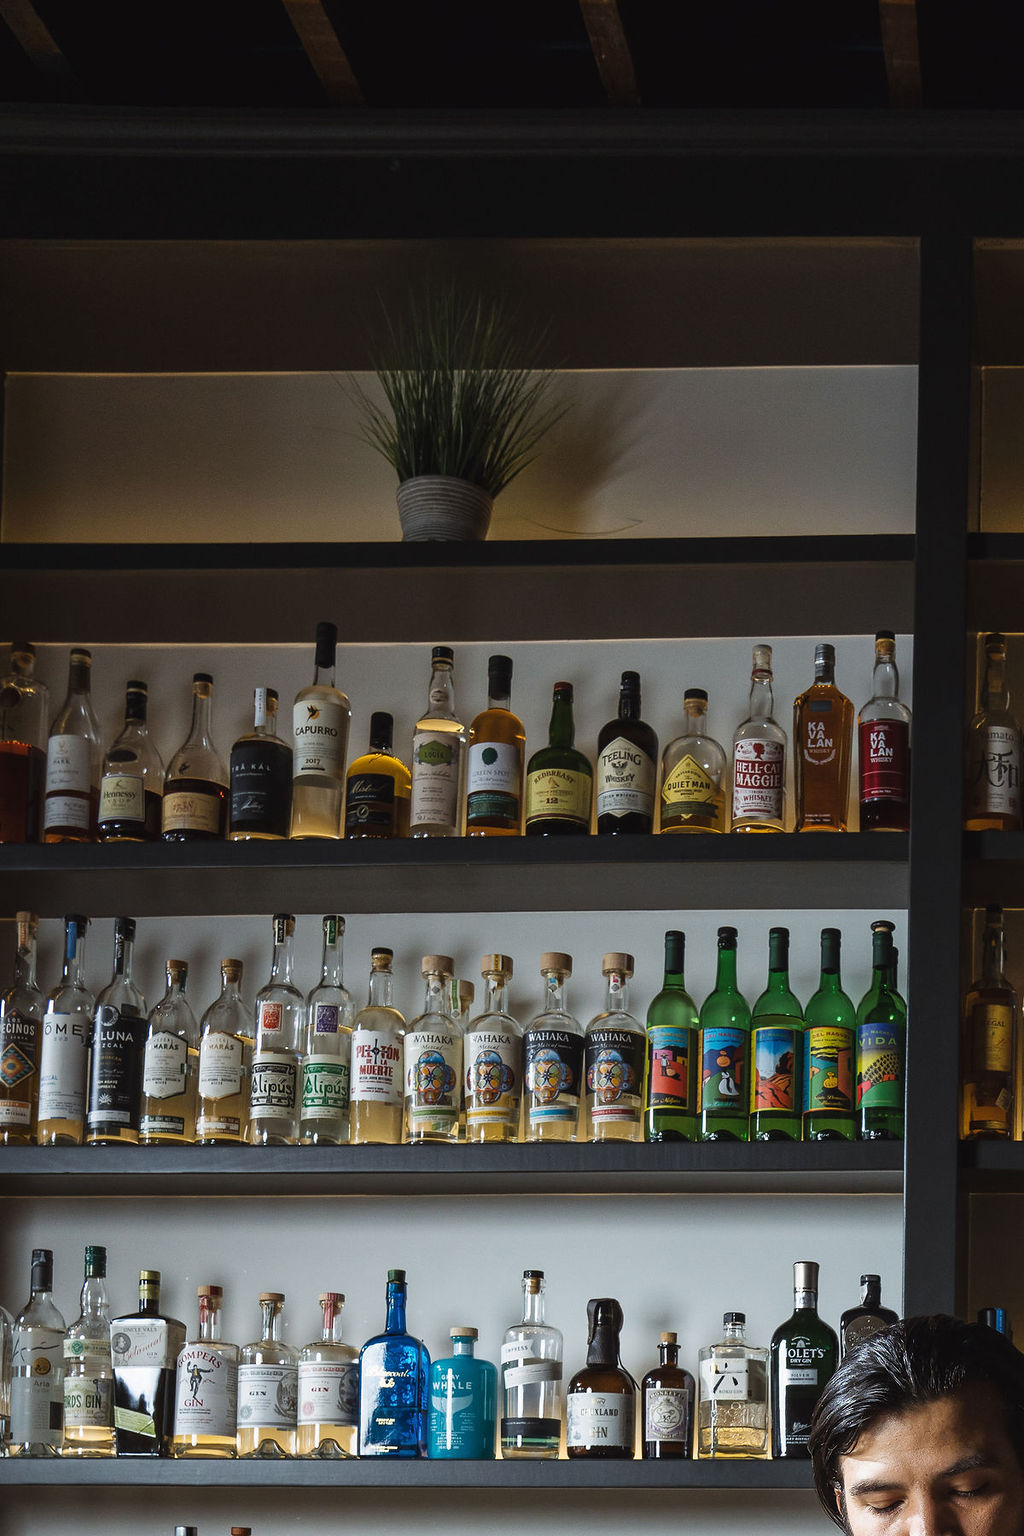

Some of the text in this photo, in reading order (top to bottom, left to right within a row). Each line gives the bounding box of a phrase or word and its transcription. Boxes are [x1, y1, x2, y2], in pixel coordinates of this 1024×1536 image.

[807, 721, 825, 731] KA
[295, 725, 338, 739] CAPURRO
[808, 731, 825, 740] VA
[870, 732, 886, 741] KA
[807, 739, 833, 748] LAN
[870, 740, 887, 750] VA
[870, 748, 894, 757] LAN
[602, 752, 642, 767] TEELING
[736, 761, 780, 773] HELL-CAT
[534, 770, 576, 785] REDBREAST
[605, 774, 635, 784] WHISKEY
[736, 773, 781, 787] MAGGIE
[667, 781, 711, 791] QUIET MAN
[742, 794, 772, 803] WHISKEY
[528, 1033, 569, 1043] WAHAKA
[591, 1033, 632, 1043] WAHAKA
[859, 1037, 897, 1047] VIDA
[359, 1065, 393, 1077] MUERTE
[252, 1074, 292, 1098] Alipús
[304, 1074, 347, 1098] Alipús
[788, 1347, 824, 1359] OLET'S
[176, 1351, 222, 1369] GOMPERS
[34, 1380, 50, 1388] Aria
[65, 1395, 102, 1409] ORDS GIN
[184, 1399, 204, 1408] GIN
